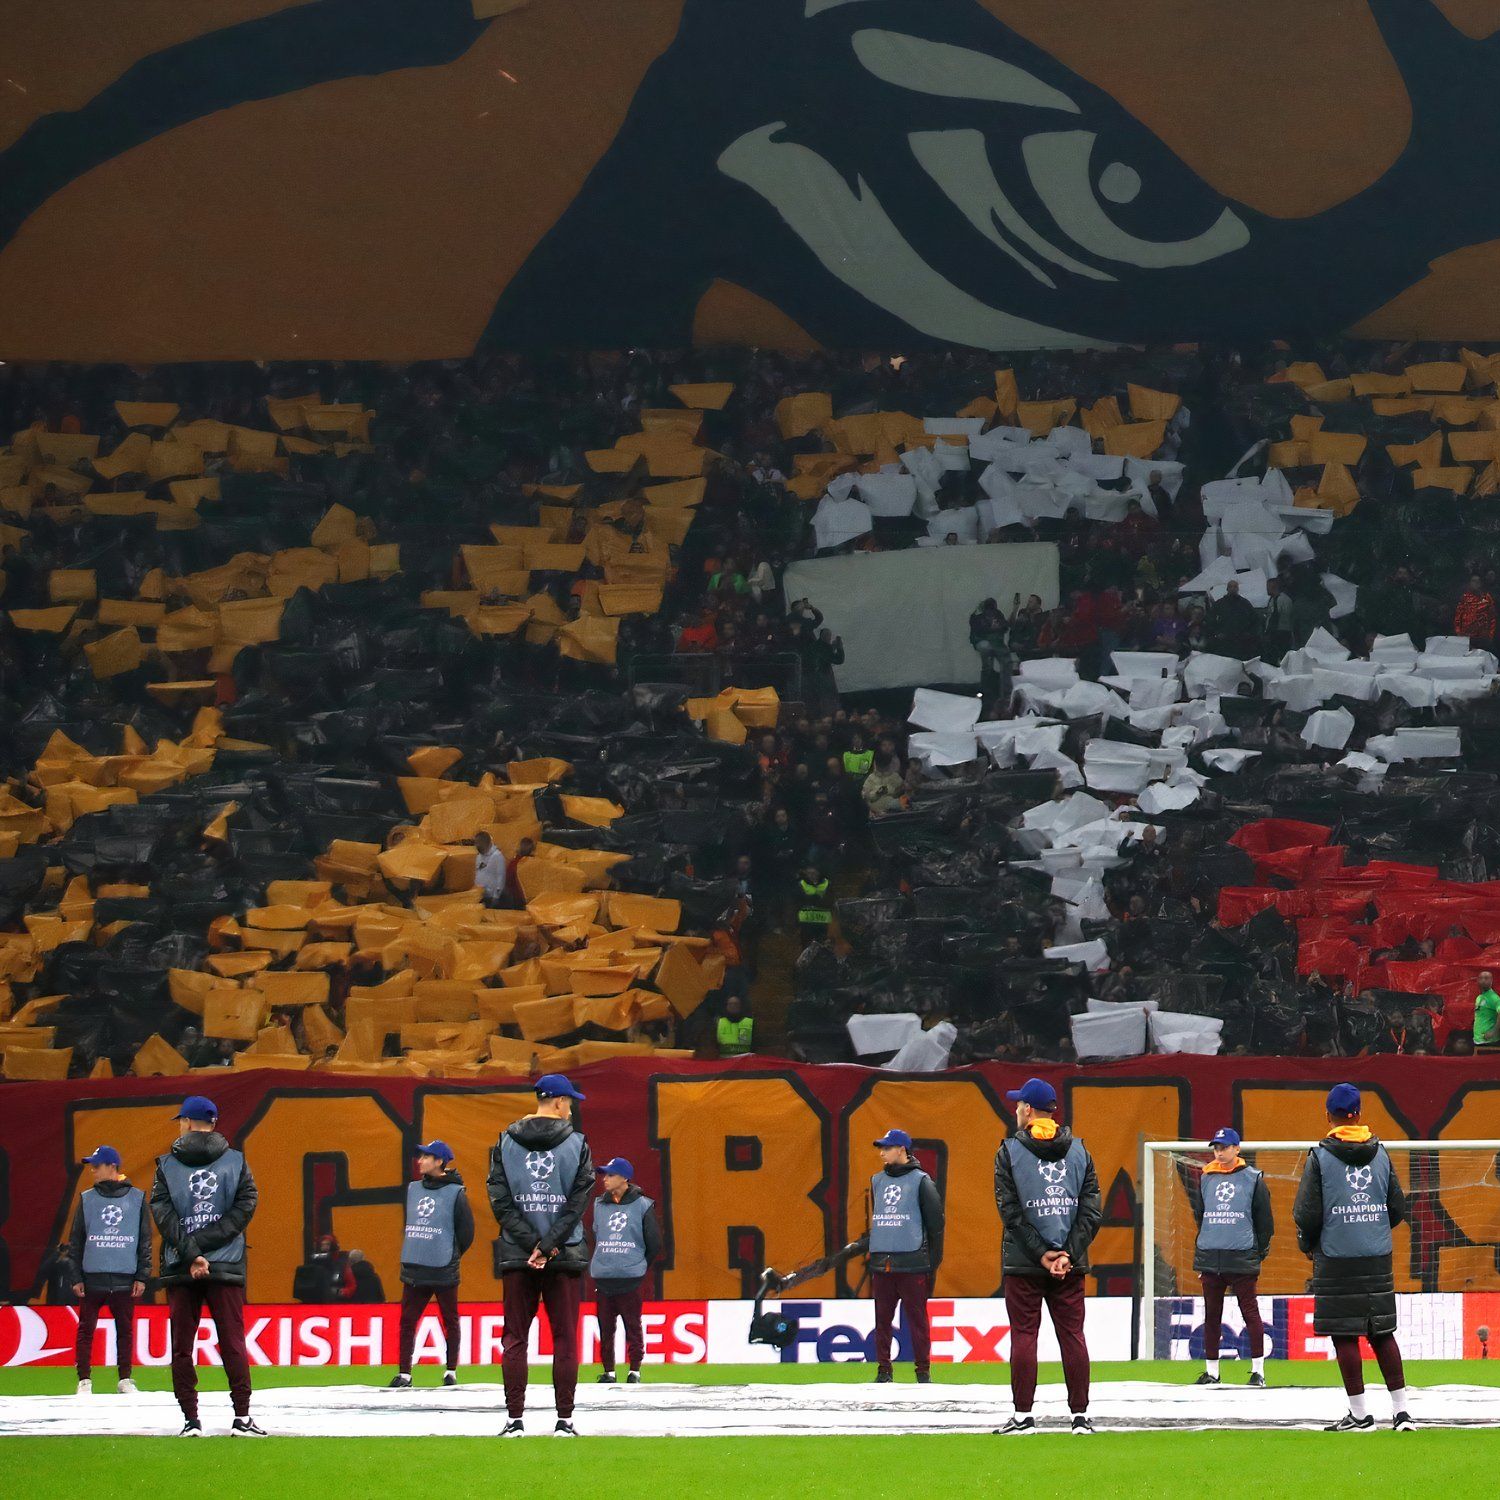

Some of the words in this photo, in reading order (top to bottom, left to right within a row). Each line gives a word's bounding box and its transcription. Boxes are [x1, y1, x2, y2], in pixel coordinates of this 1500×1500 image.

[1038, 1206, 1070, 1217] LEAGU
[1203, 1211, 1245, 1219] CHAMPIONS
[1332, 1204, 1388, 1215] CHAMPIONS
[1343, 1213, 1380, 1224] LEAGUE
[89, 1234, 135, 1243] CHAMPIONS
[781, 1301, 1011, 1363] FedEx
[411, 1314, 707, 1366] AIRLNES
